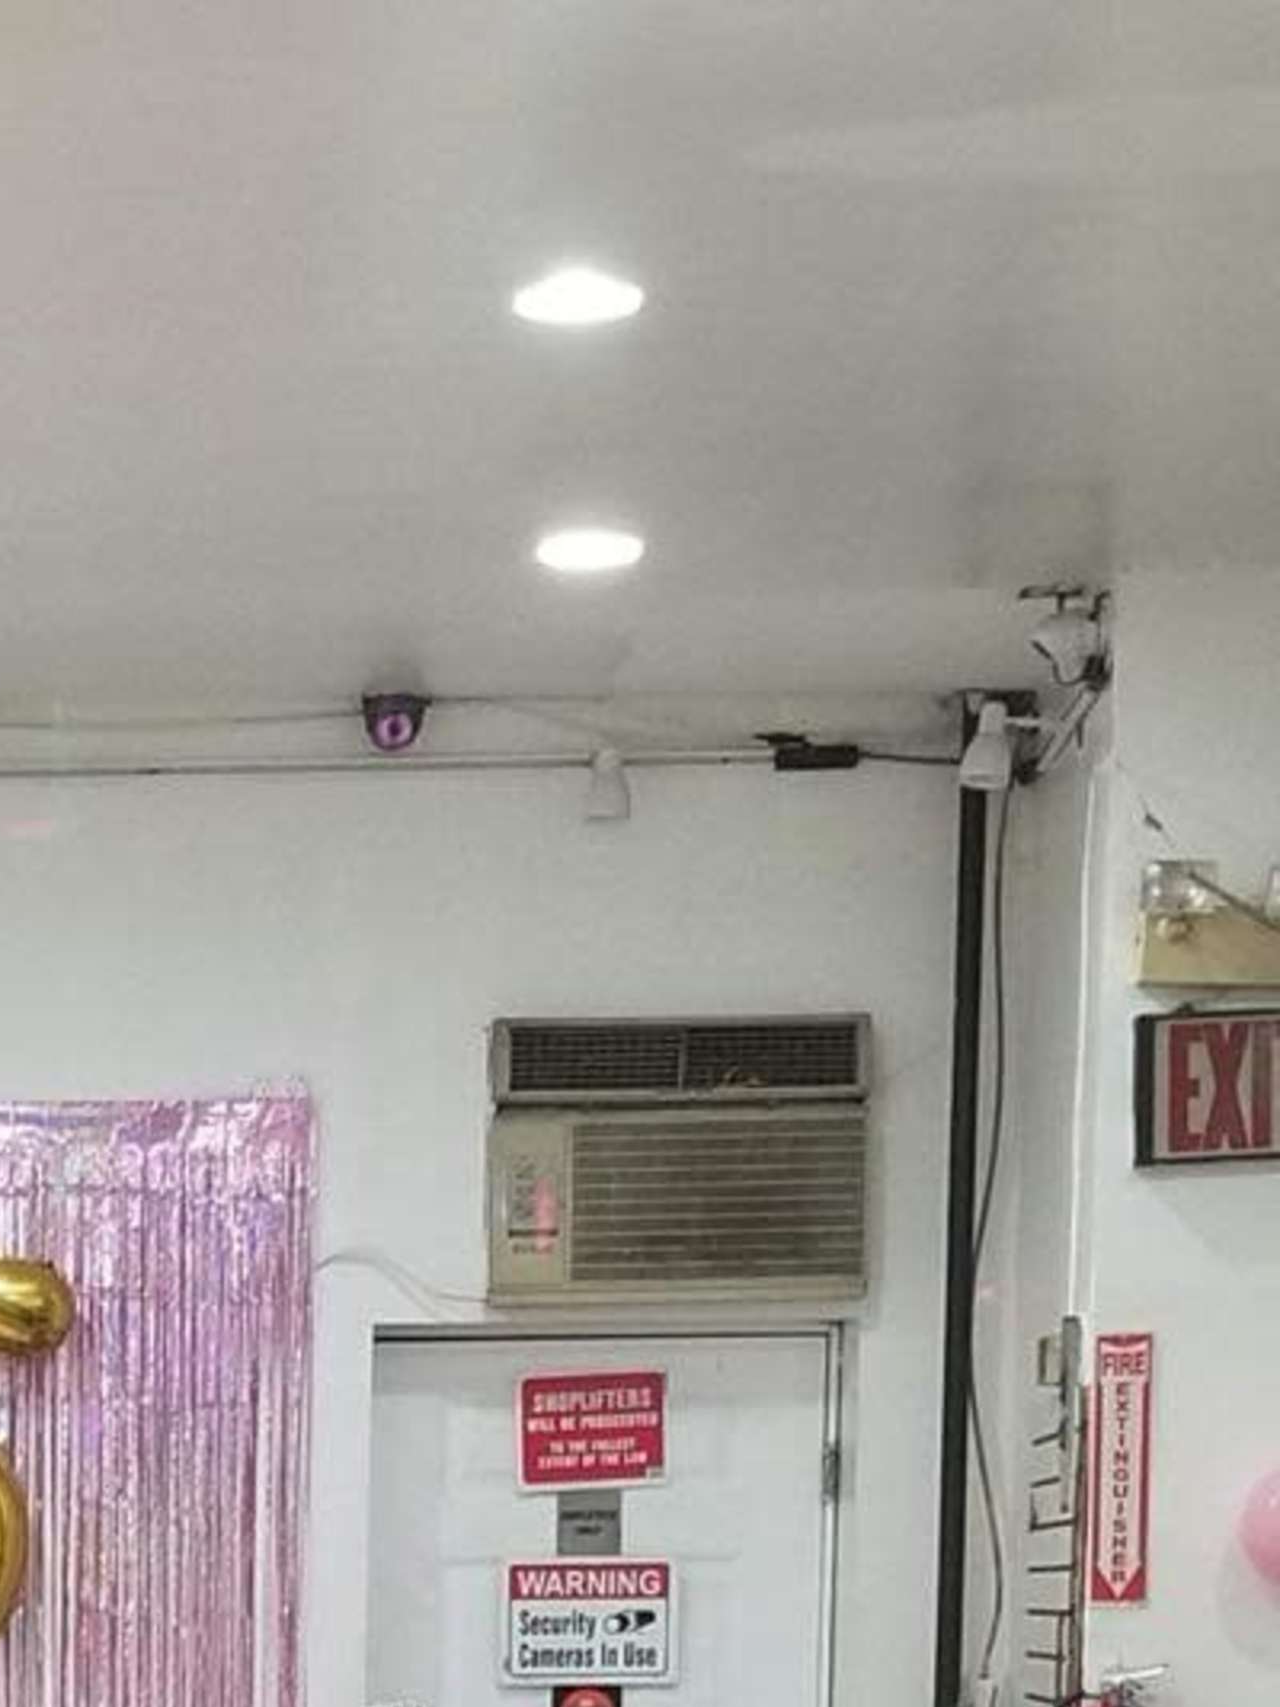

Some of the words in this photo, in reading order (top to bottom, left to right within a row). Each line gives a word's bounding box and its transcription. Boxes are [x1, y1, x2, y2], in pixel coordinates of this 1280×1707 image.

[1168, 1021, 1280, 1152] EXI
[1100, 1352, 1146, 1377] FIRE
[1110, 1382, 1131, 1583] EXTINGUISHER
[516, 1569, 662, 1597] WARNING
[519, 1609, 596, 1641] Security
[519, 1643, 595, 1669] Cameras
[601, 1642, 618, 1667] In
[623, 1641, 657, 1668] Use
